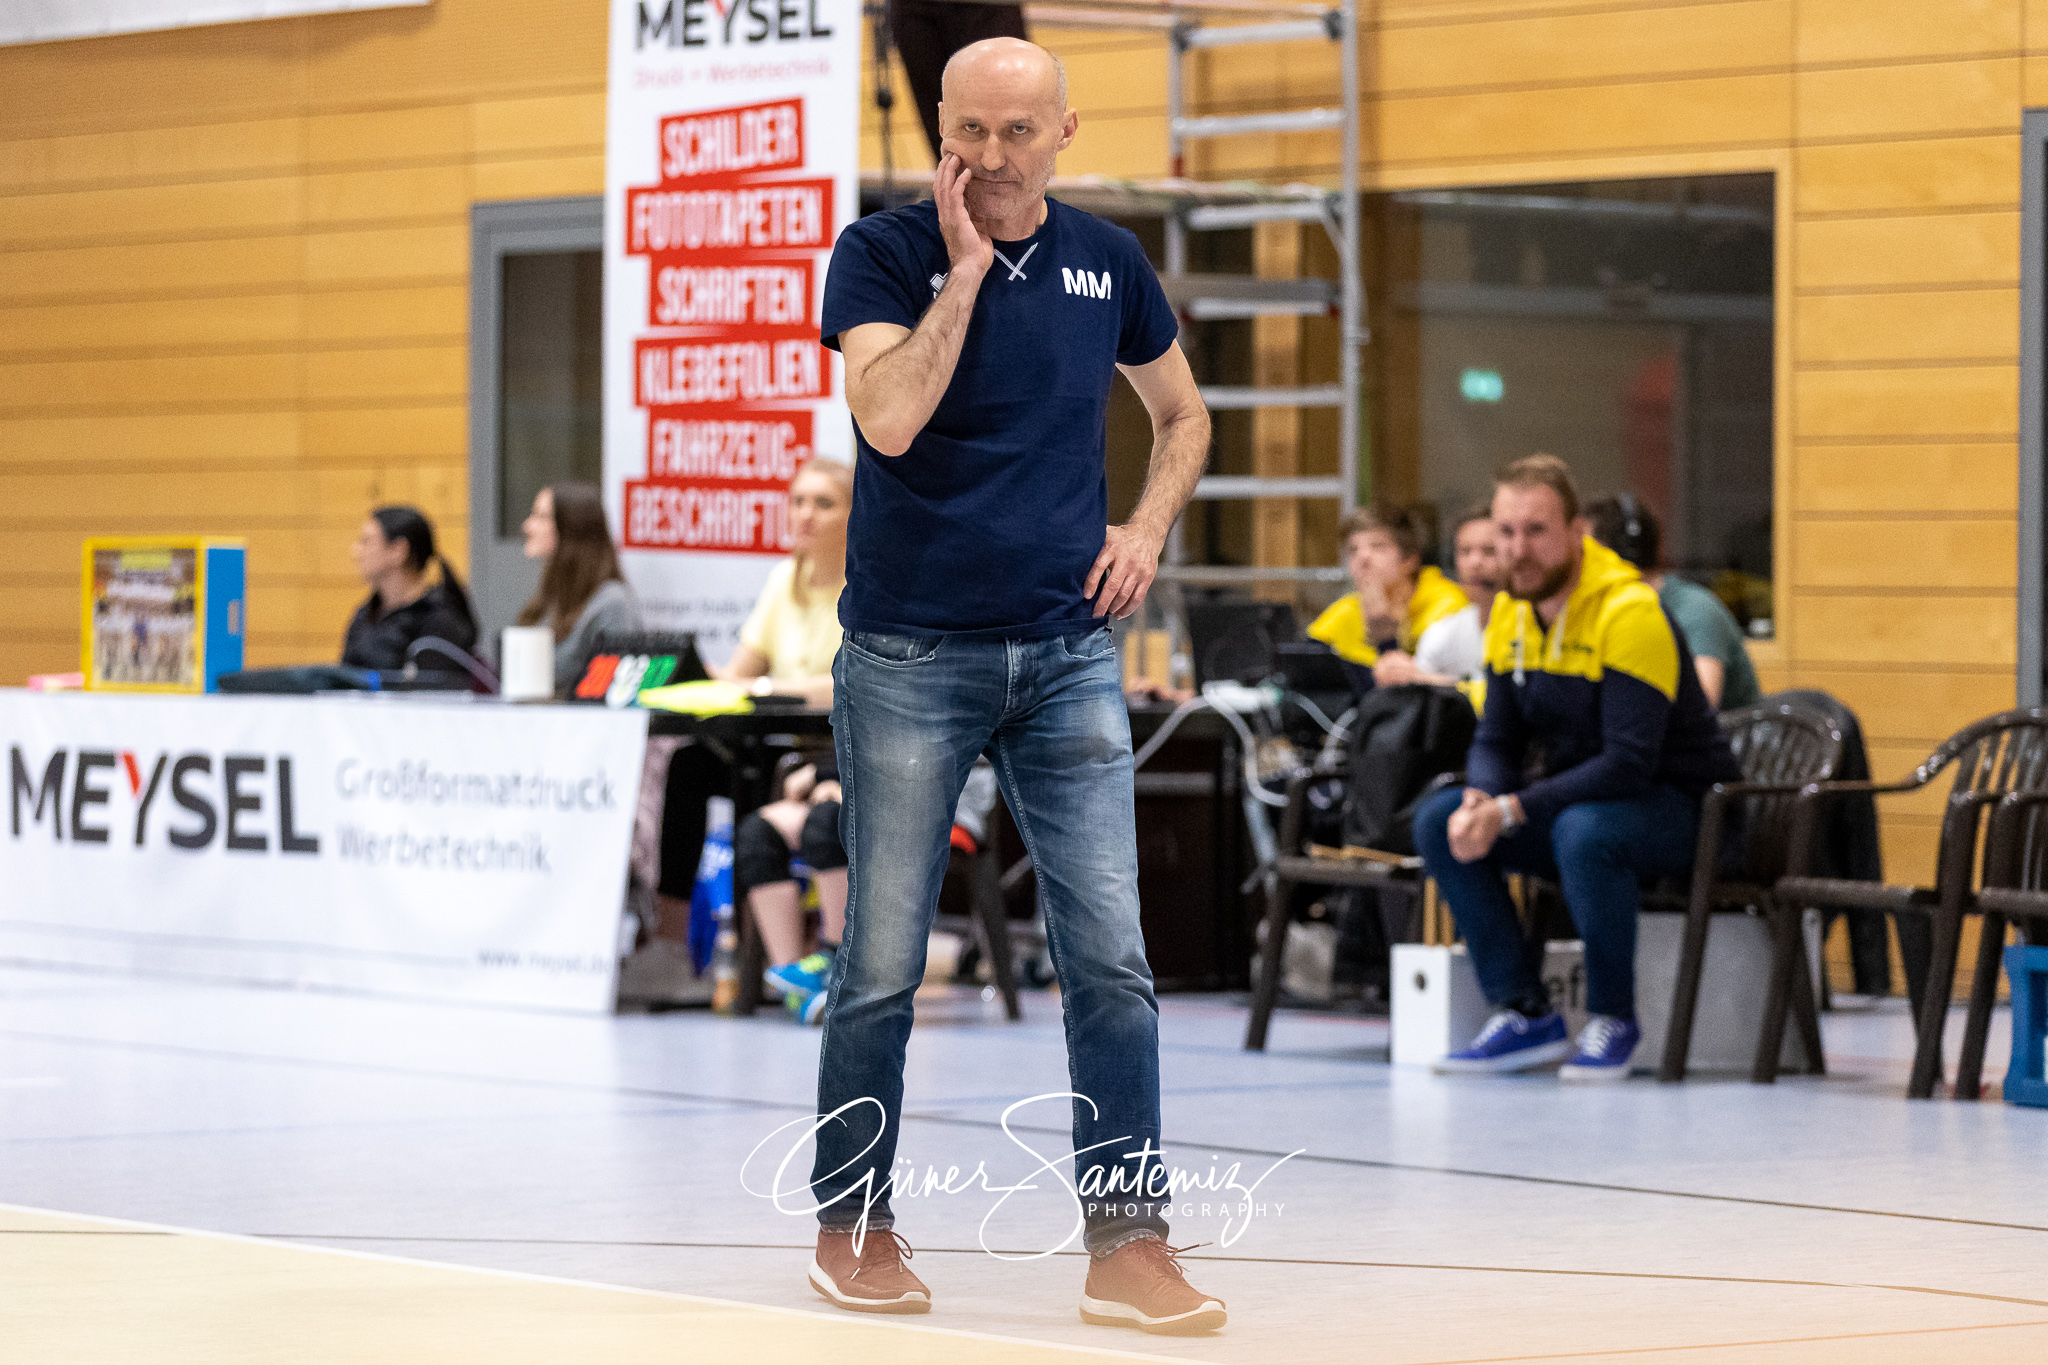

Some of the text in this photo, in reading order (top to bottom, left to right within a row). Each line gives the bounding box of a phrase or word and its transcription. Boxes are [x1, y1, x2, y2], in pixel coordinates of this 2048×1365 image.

[635, 0, 834, 50] MEYSEL
[662, 104, 799, 179] SCHILDER
[632, 186, 823, 251] FOTOTAPETEN
[656, 265, 805, 323] SCHRIFTEN
[1061, 267, 1112, 300] MM
[639, 339, 821, 404] KLEBEFOLIEN
[626, 485, 796, 549] BESCHRIFTU
[8, 741, 322, 856] MEYSEL
[336, 821, 553, 876] Werbetechnik
